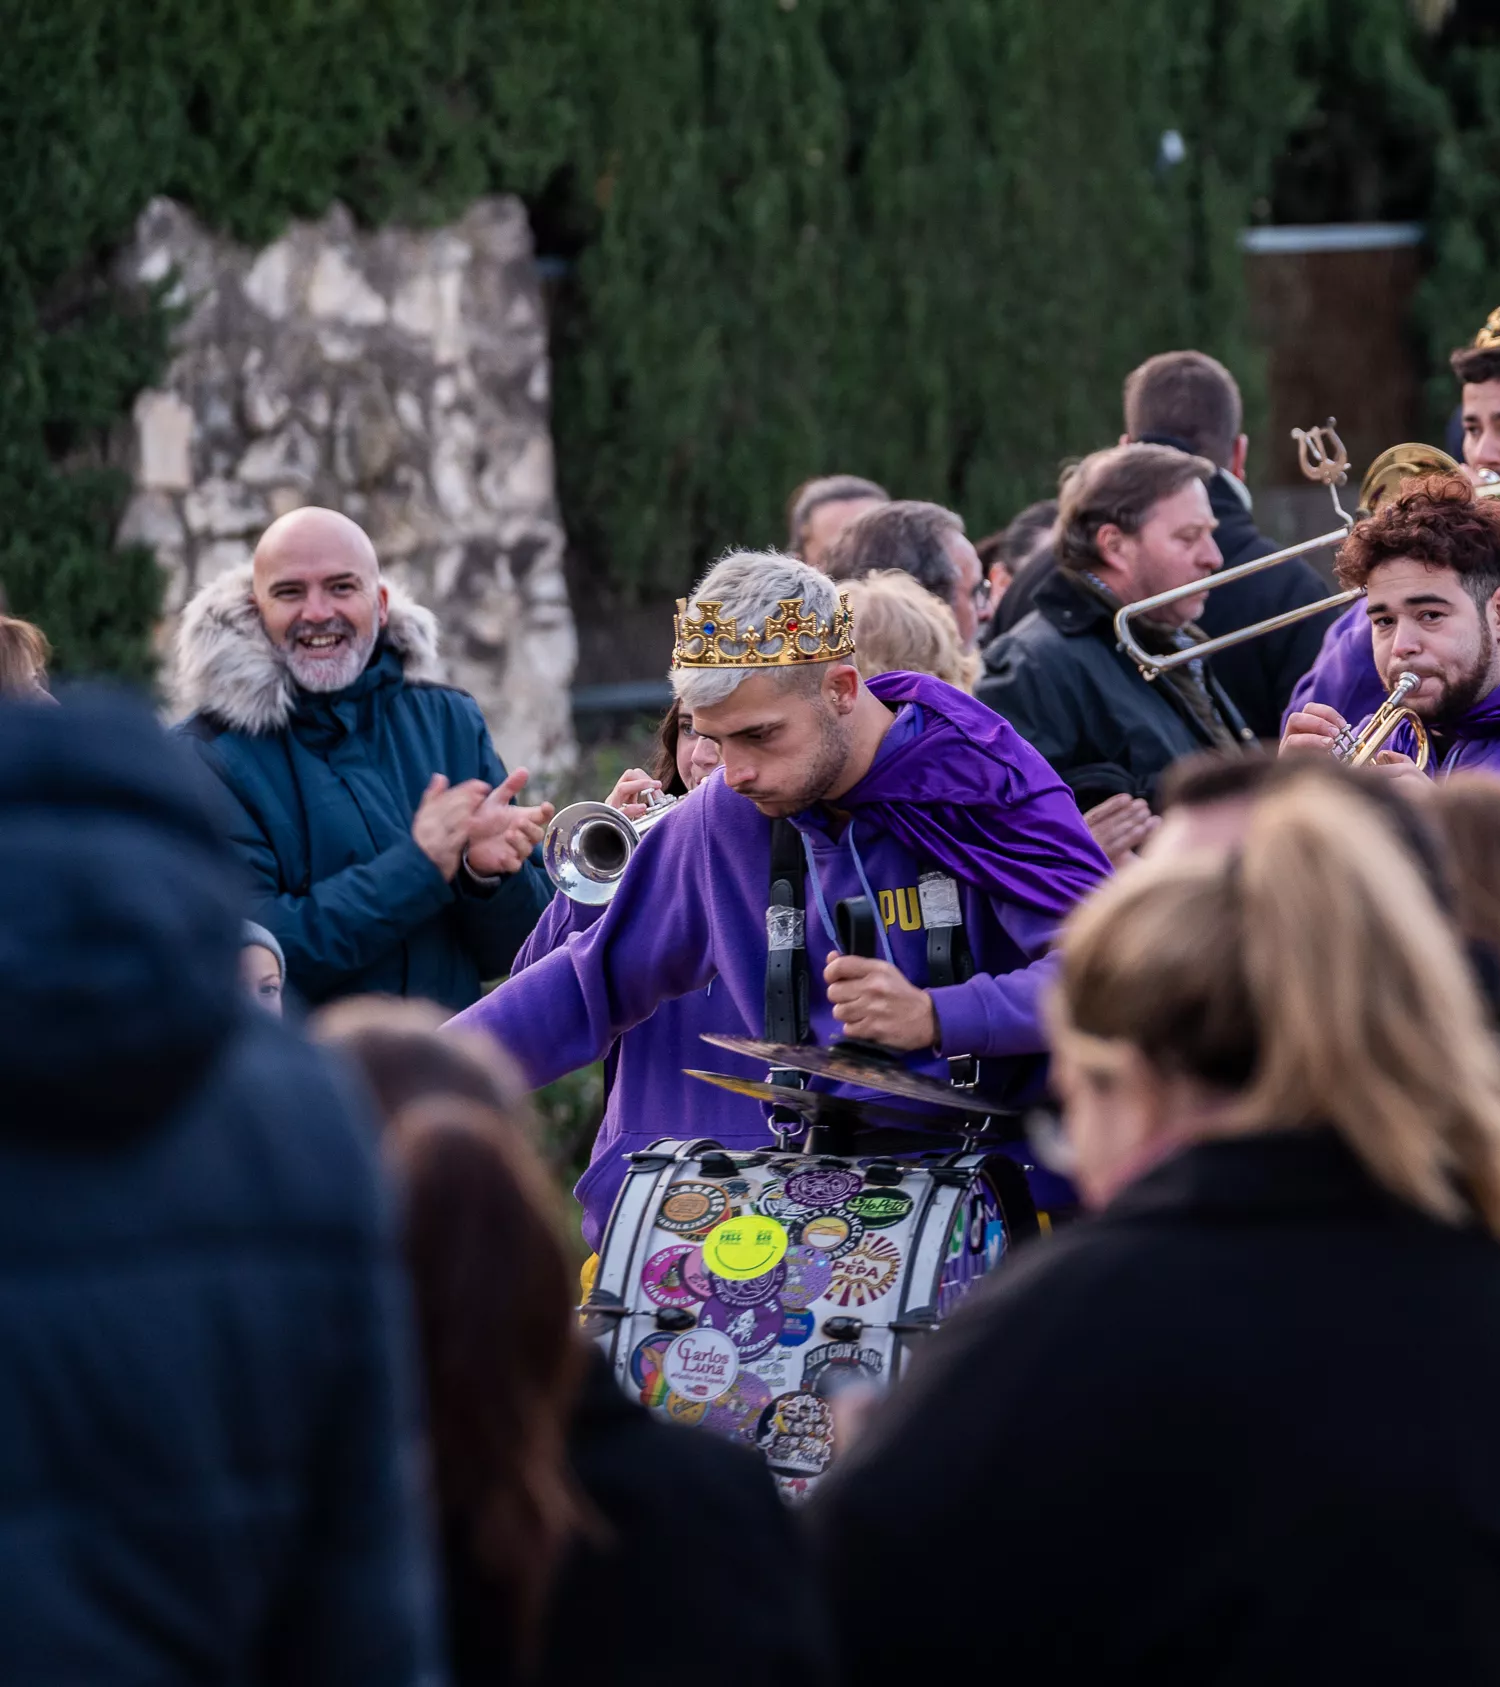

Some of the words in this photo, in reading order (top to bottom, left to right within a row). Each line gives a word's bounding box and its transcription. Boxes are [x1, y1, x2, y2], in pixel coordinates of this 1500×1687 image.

[878, 886, 922, 934] PU
[796, 1208, 832, 1224] PLAY
[836, 1209, 863, 1237] DANCE
[651, 1250, 671, 1267] LOS
[832, 1261, 879, 1279] PEPA
[677, 1338, 730, 1364] Carlos
[682, 1348, 725, 1377] Luna
